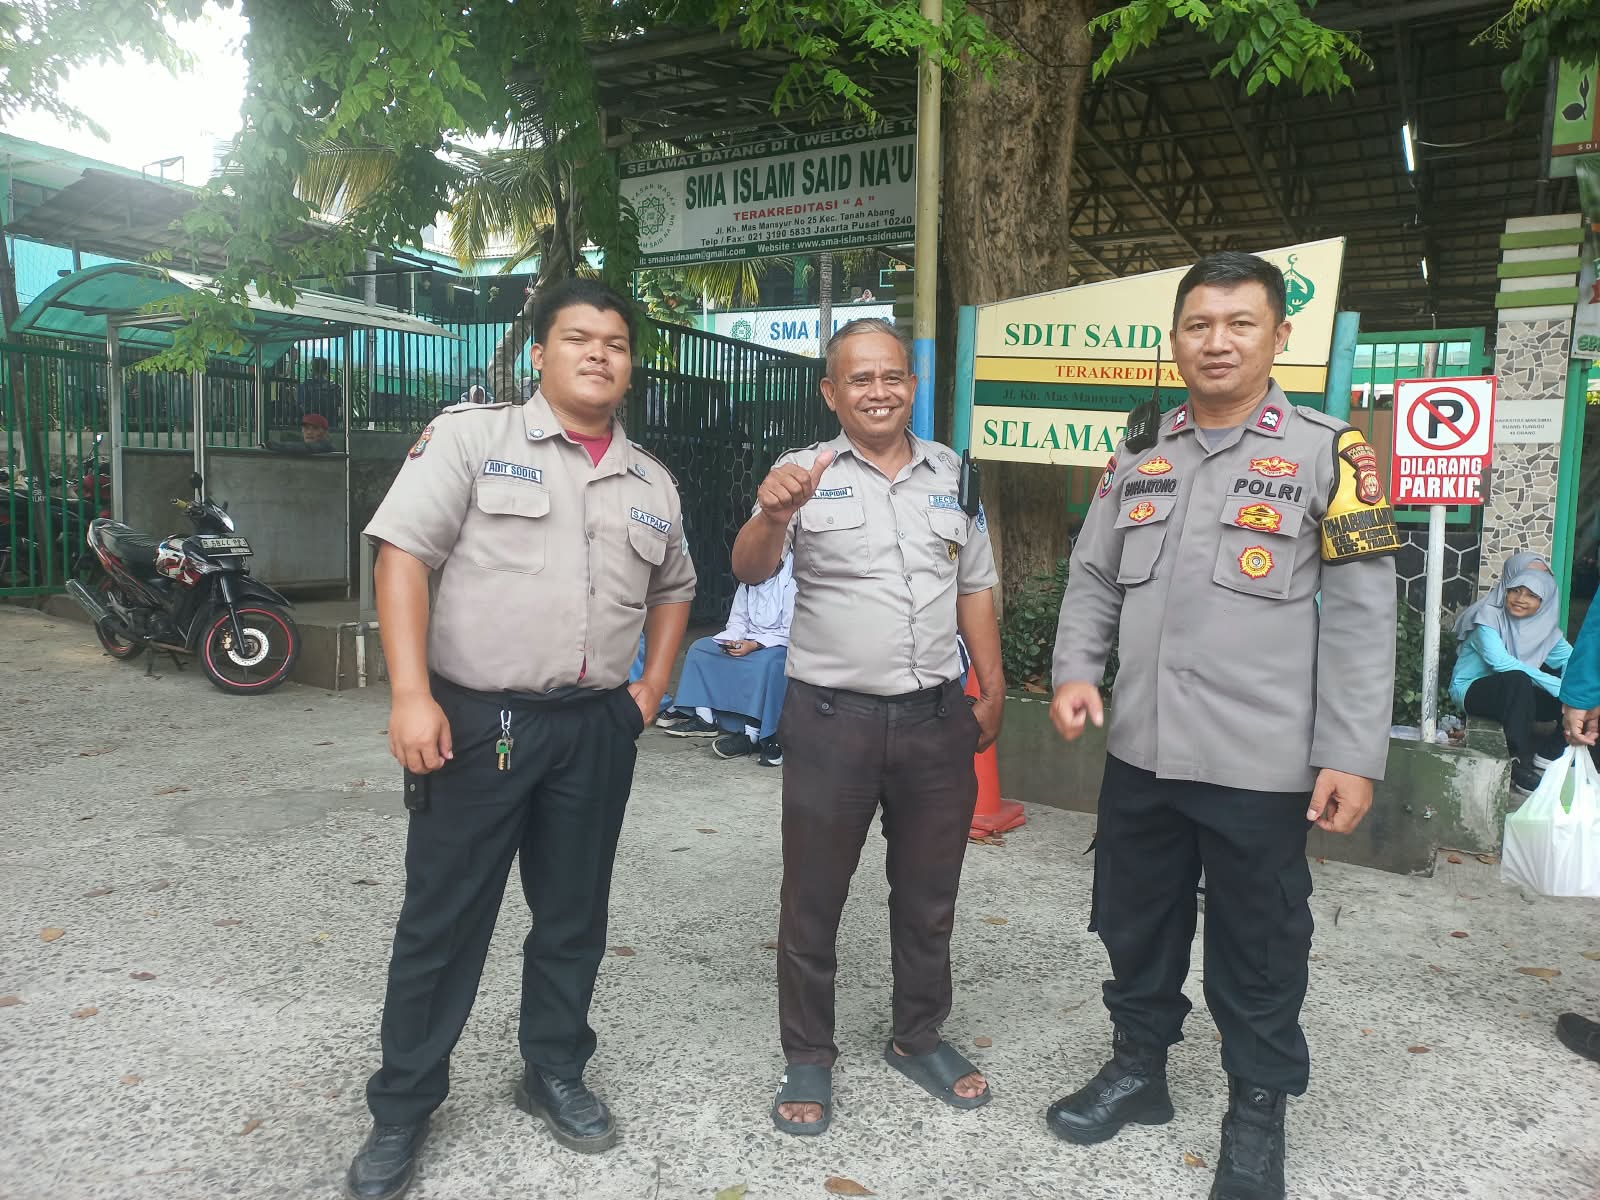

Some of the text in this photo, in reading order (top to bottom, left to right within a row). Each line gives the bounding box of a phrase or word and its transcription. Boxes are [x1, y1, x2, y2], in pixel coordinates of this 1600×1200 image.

[628, 154, 697, 174] SELAMAT
[701, 143, 767, 162] DATANG
[771, 140, 788, 151] DI
[804, 121, 895, 146] WELCOME
[685, 143, 917, 211] SMA ISLAM SAID NA'U
[726, 225, 740, 233] Kh.
[741, 223, 757, 232] Mas
[758, 219, 793, 233] Mansyur
[794, 217, 805, 226] No
[807, 216, 817, 224] 25
[819, 214, 838, 223] Kec.
[840, 209, 865, 221] Tanah
[868, 207, 896, 219] Abang
[733, 199, 839, 222] TERAKREDITASI
[701, 236, 718, 248] Telp
[726, 234, 746, 244] Fax:
[747, 231, 763, 241] 021
[766, 230, 787, 241] 3190
[789, 227, 811, 237] 5833
[814, 222, 849, 234] Jakarta
[852, 220, 880, 230] Pusat
[883, 215, 912, 226] 10240
[757, 241, 790, 254] Website
[797, 229, 916, 249] www.sma-islam-saidnaum.
[769, 319, 810, 341] SMA
[1004, 322, 1163, 349] SDIT SAID
[1055, 364, 1187, 383] TERAKREDITAS
[1044, 391, 1068, 402] Mas
[488, 461, 508, 474] ADIT
[1400, 456, 1483, 476] DILARANG
[819, 487, 848, 498] HAPIDIN
[933, 495, 957, 504] SECU
[1233, 477, 1303, 503] POLRI
[632, 510, 669, 532] SATPAM
